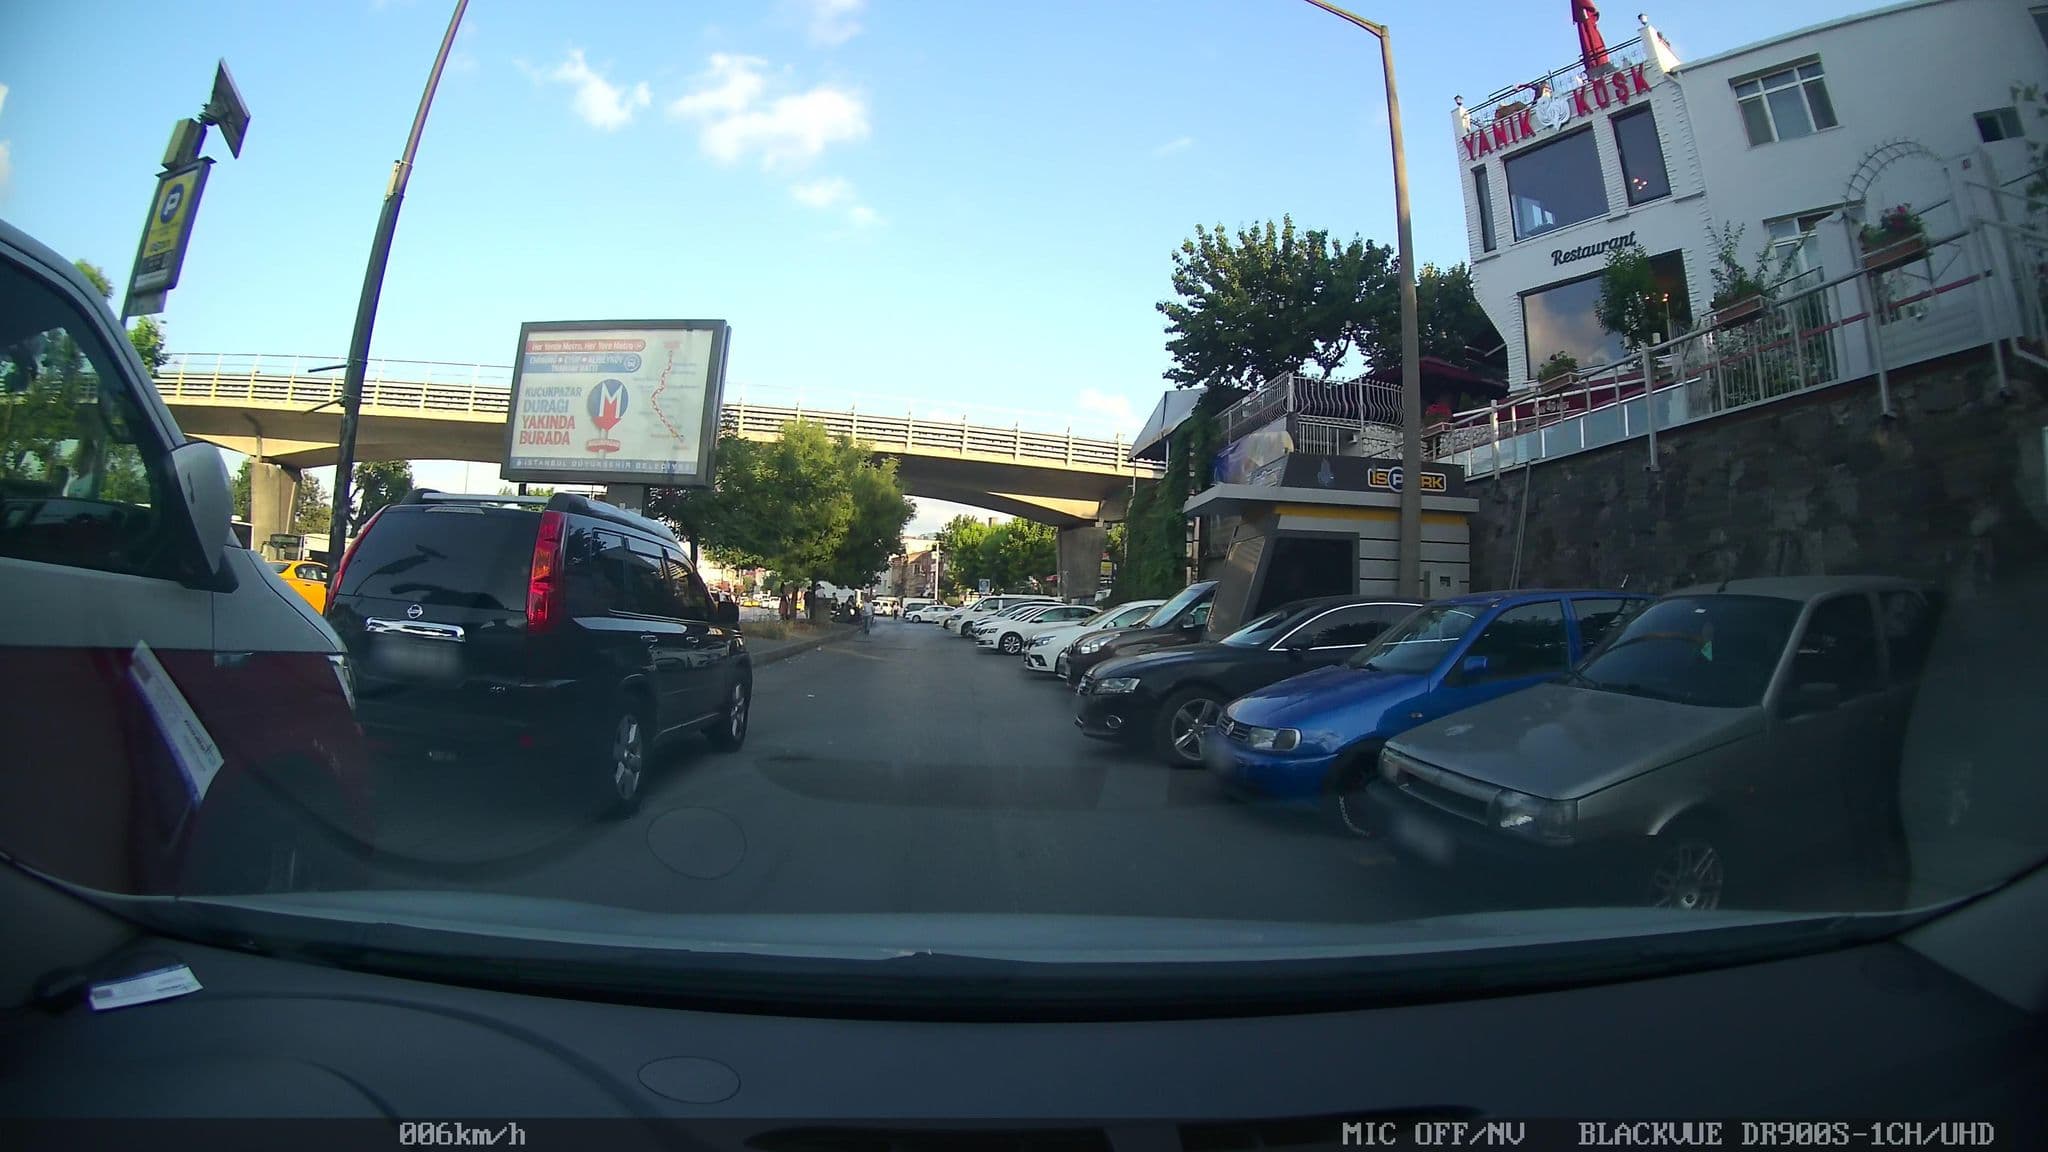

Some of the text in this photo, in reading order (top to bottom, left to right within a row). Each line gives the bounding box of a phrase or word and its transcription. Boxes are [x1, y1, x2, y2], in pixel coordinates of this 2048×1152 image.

[1463, 108, 1536, 160] YANIK
[1551, 231, 1637, 266] Restaurant
[521, 415, 575, 429] YAKINDA
[519, 431, 570, 445] BURADA
